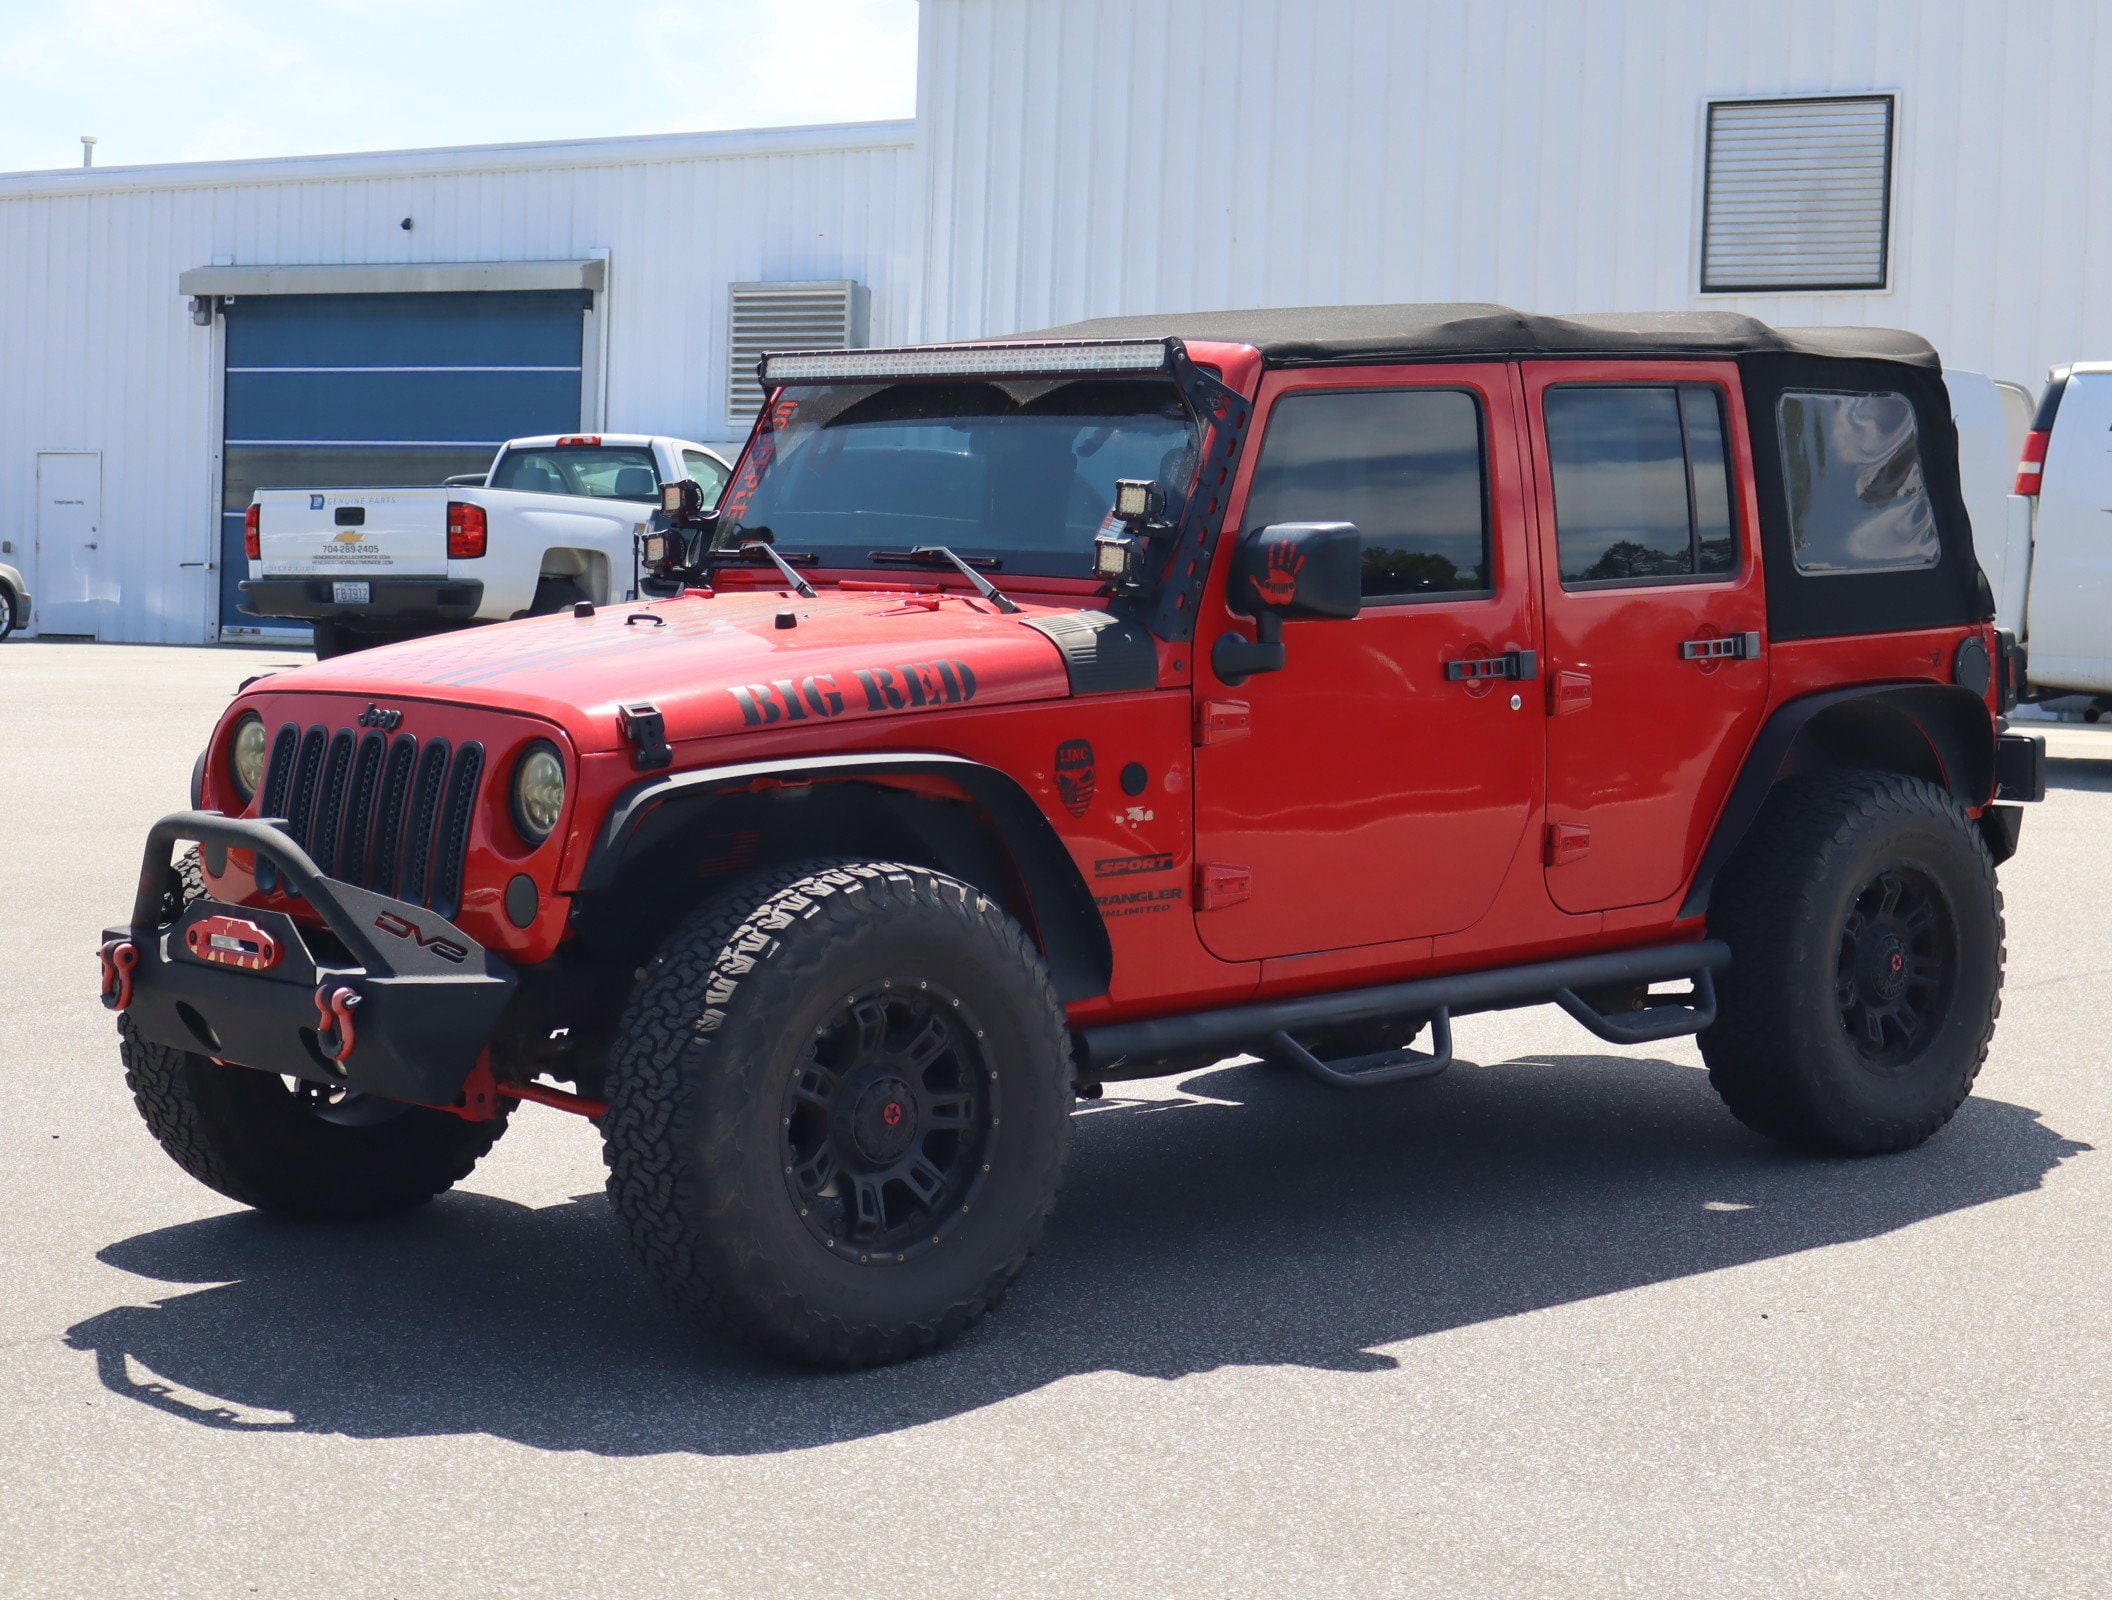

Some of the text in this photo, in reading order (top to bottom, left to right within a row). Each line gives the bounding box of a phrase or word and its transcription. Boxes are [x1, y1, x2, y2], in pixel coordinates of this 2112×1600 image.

[368, 496, 397, 504] PARTS
[322, 545, 379, 553] 704-289-2405
[727, 659, 978, 727] BIG RED
[358, 702, 403, 733] Jeep
[1100, 857, 1168, 874] SPORT
[1094, 888, 1183, 906] RANGLER
